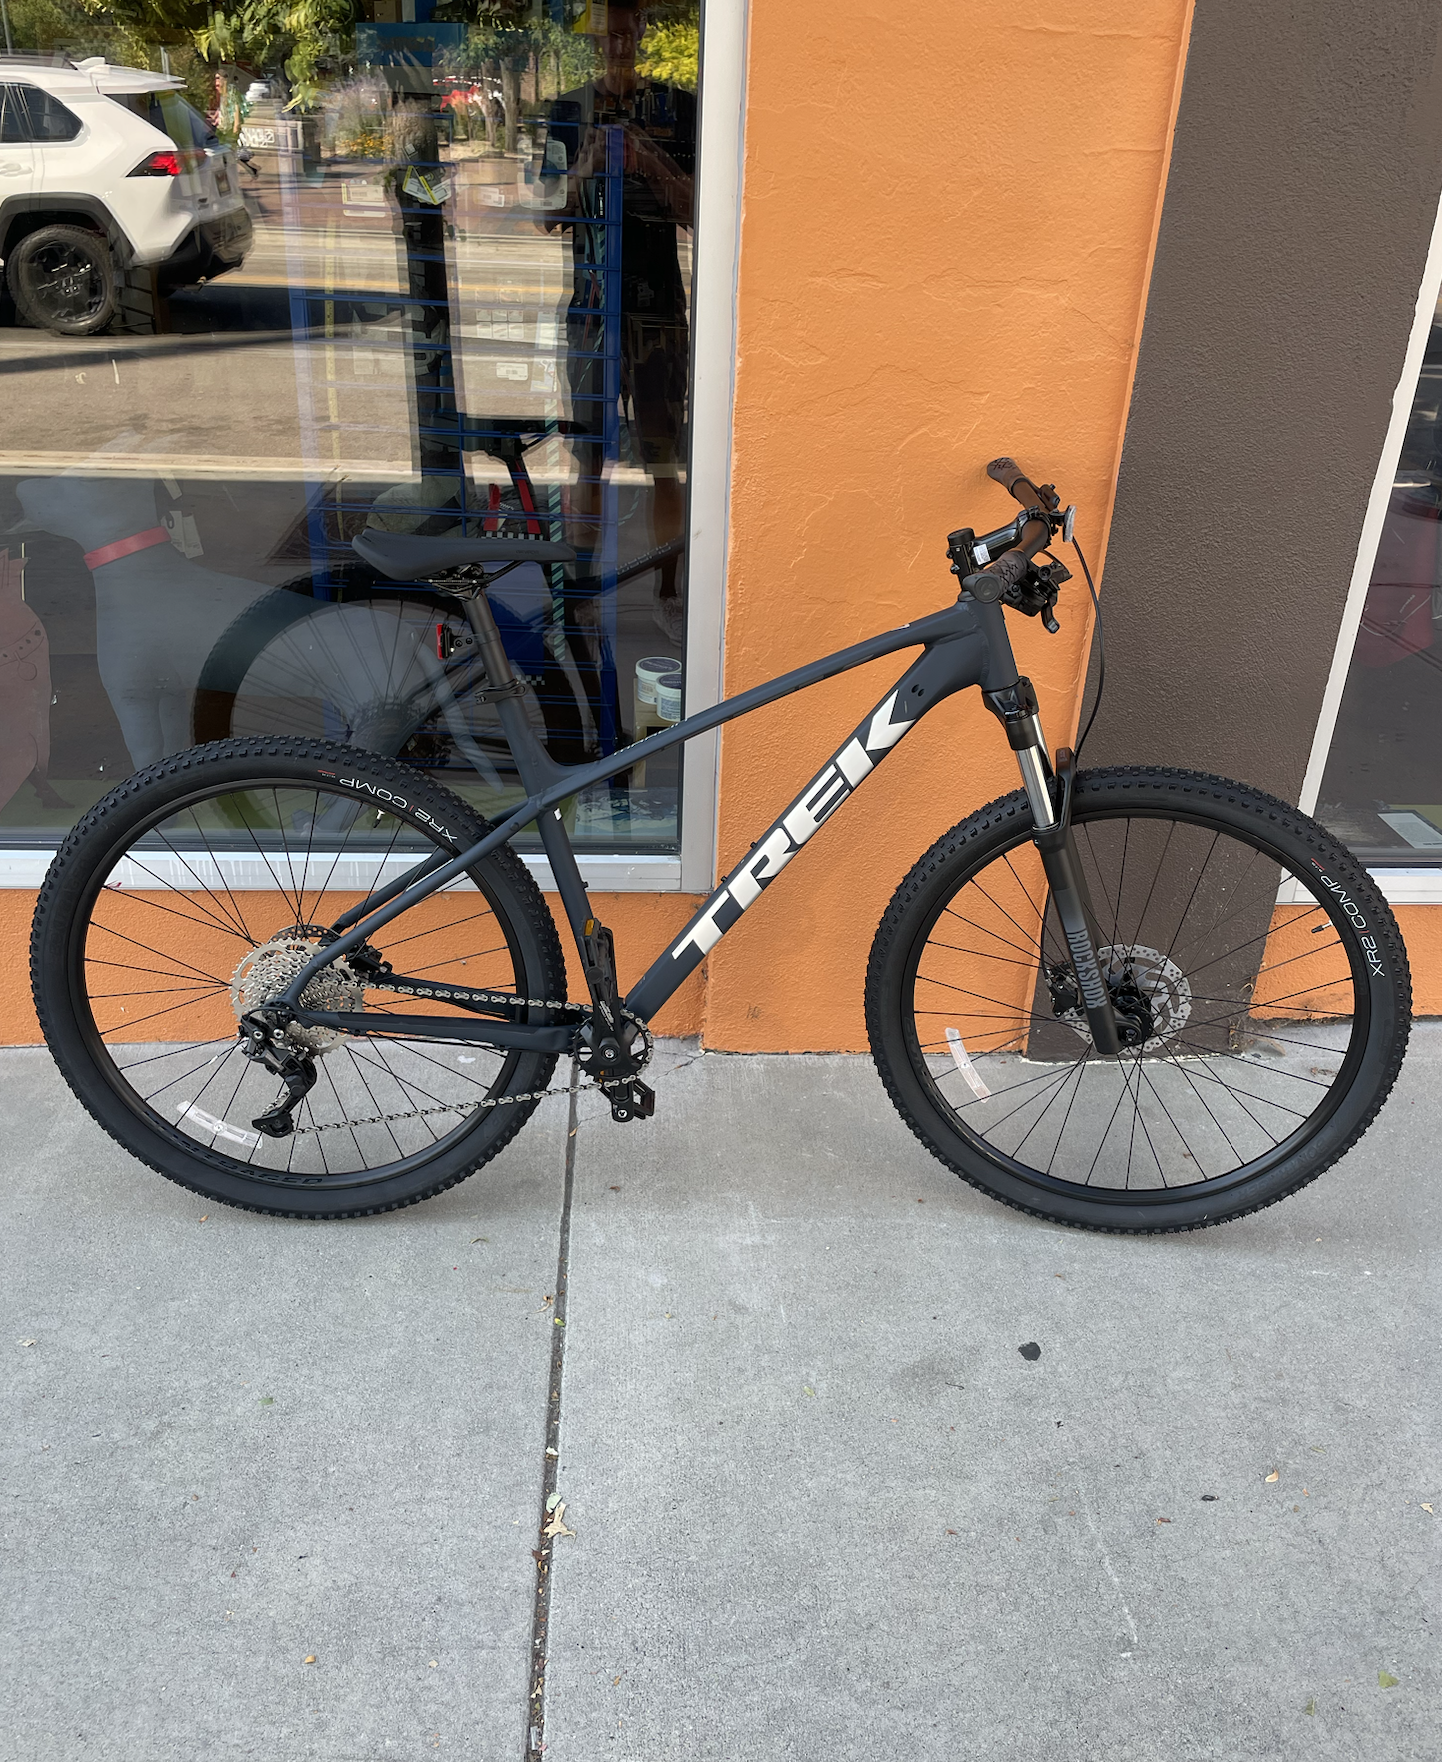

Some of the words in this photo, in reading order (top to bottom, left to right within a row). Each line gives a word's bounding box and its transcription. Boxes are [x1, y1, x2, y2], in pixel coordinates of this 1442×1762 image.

[339, 777, 408, 810] COMP
[414, 806, 458, 843] XR2
[672, 689, 916, 960] TREK
[1320, 874, 1367, 930] COMP
[1066, 929, 1108, 1010] ROCKSHOX
[1360, 935, 1385, 977] XR2
